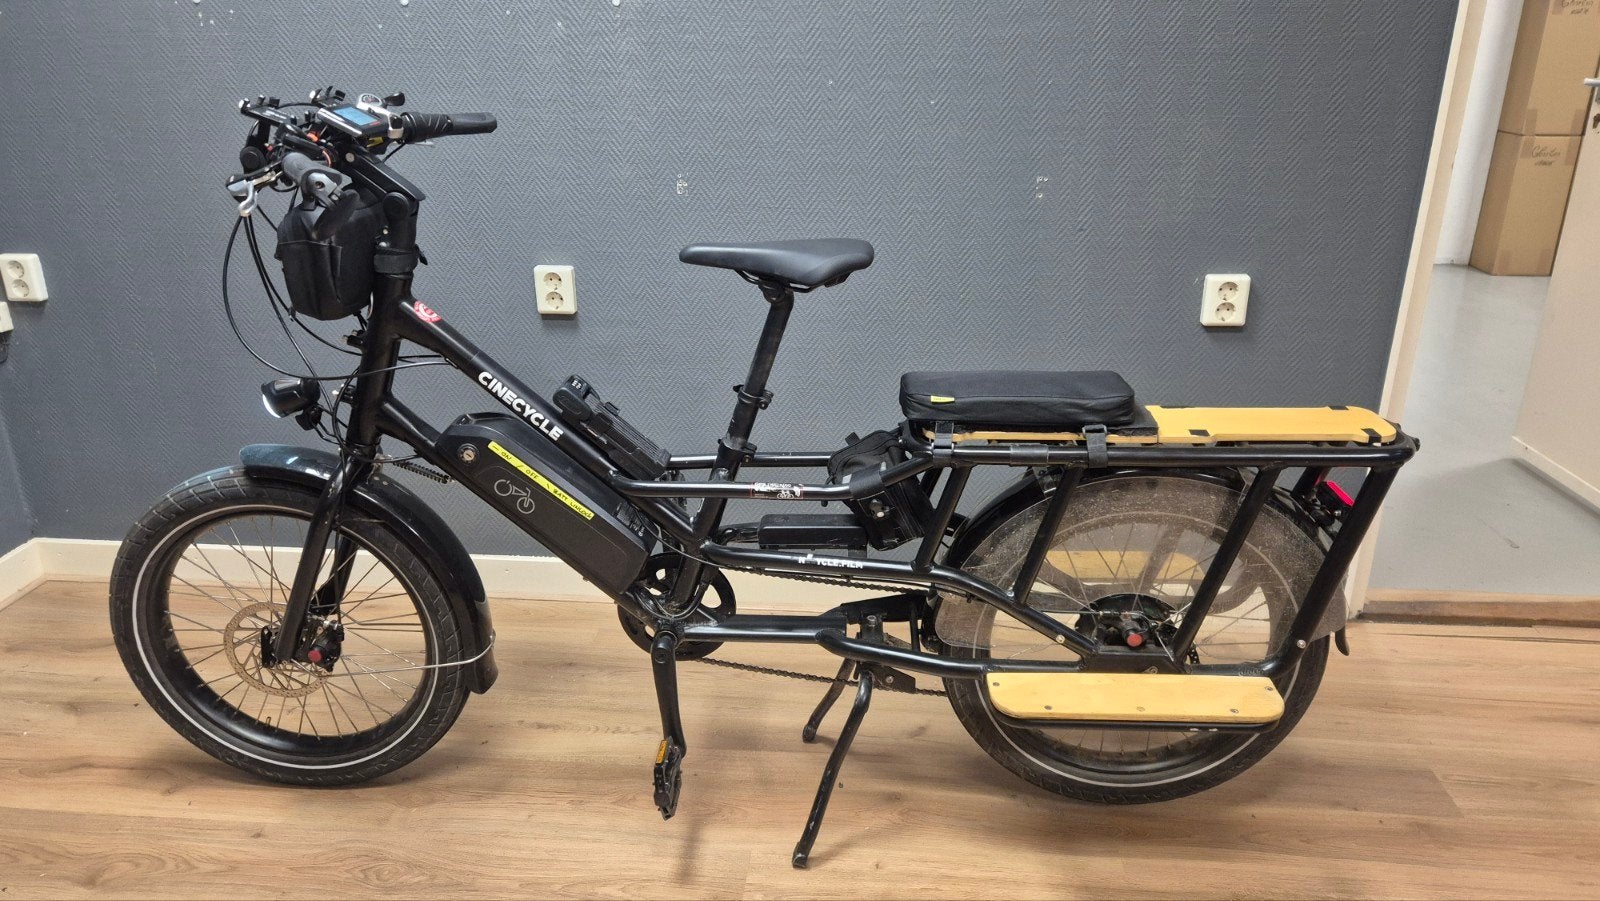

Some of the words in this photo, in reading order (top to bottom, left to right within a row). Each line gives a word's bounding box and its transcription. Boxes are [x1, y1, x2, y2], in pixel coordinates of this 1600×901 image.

[478, 371, 564, 441] CINECYCLE
[501, 451, 512, 461] ON
[525, 469, 539, 479] OFF
